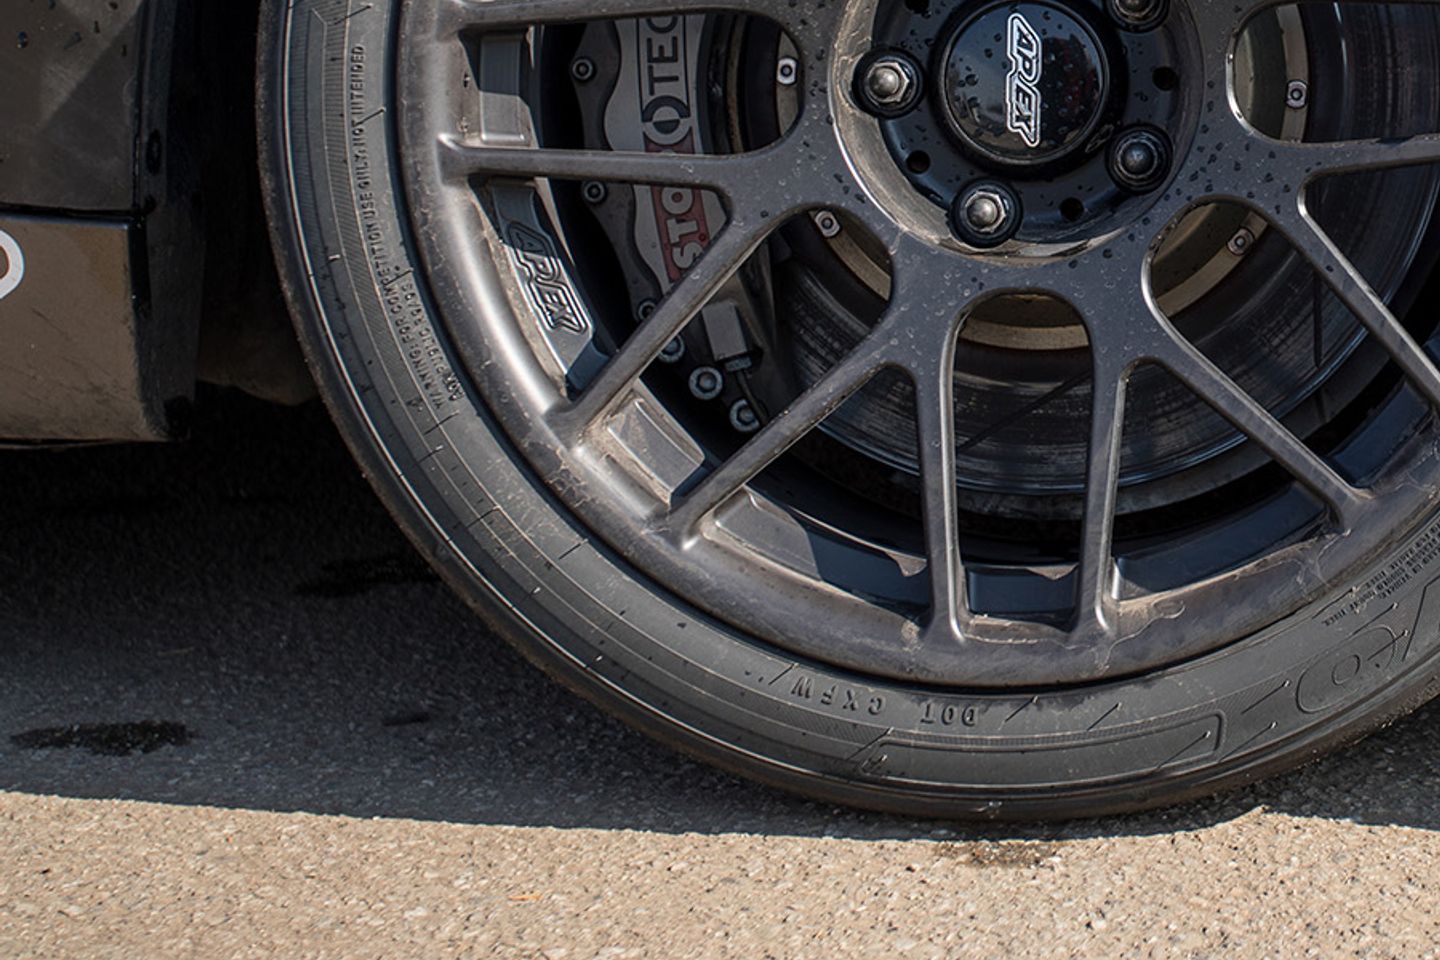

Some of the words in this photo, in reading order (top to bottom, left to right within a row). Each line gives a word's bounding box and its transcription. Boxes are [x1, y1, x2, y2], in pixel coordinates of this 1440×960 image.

[350, 45, 364, 113] INTENDED
[1006, 13, 1042, 147] APEX
[359, 191, 377, 219] USE
[365, 221, 404, 315] COMPETITION
[508, 220, 588, 335] APEX
[414, 323, 448, 374] PUBLIC
[919, 702, 979, 727] DOT
